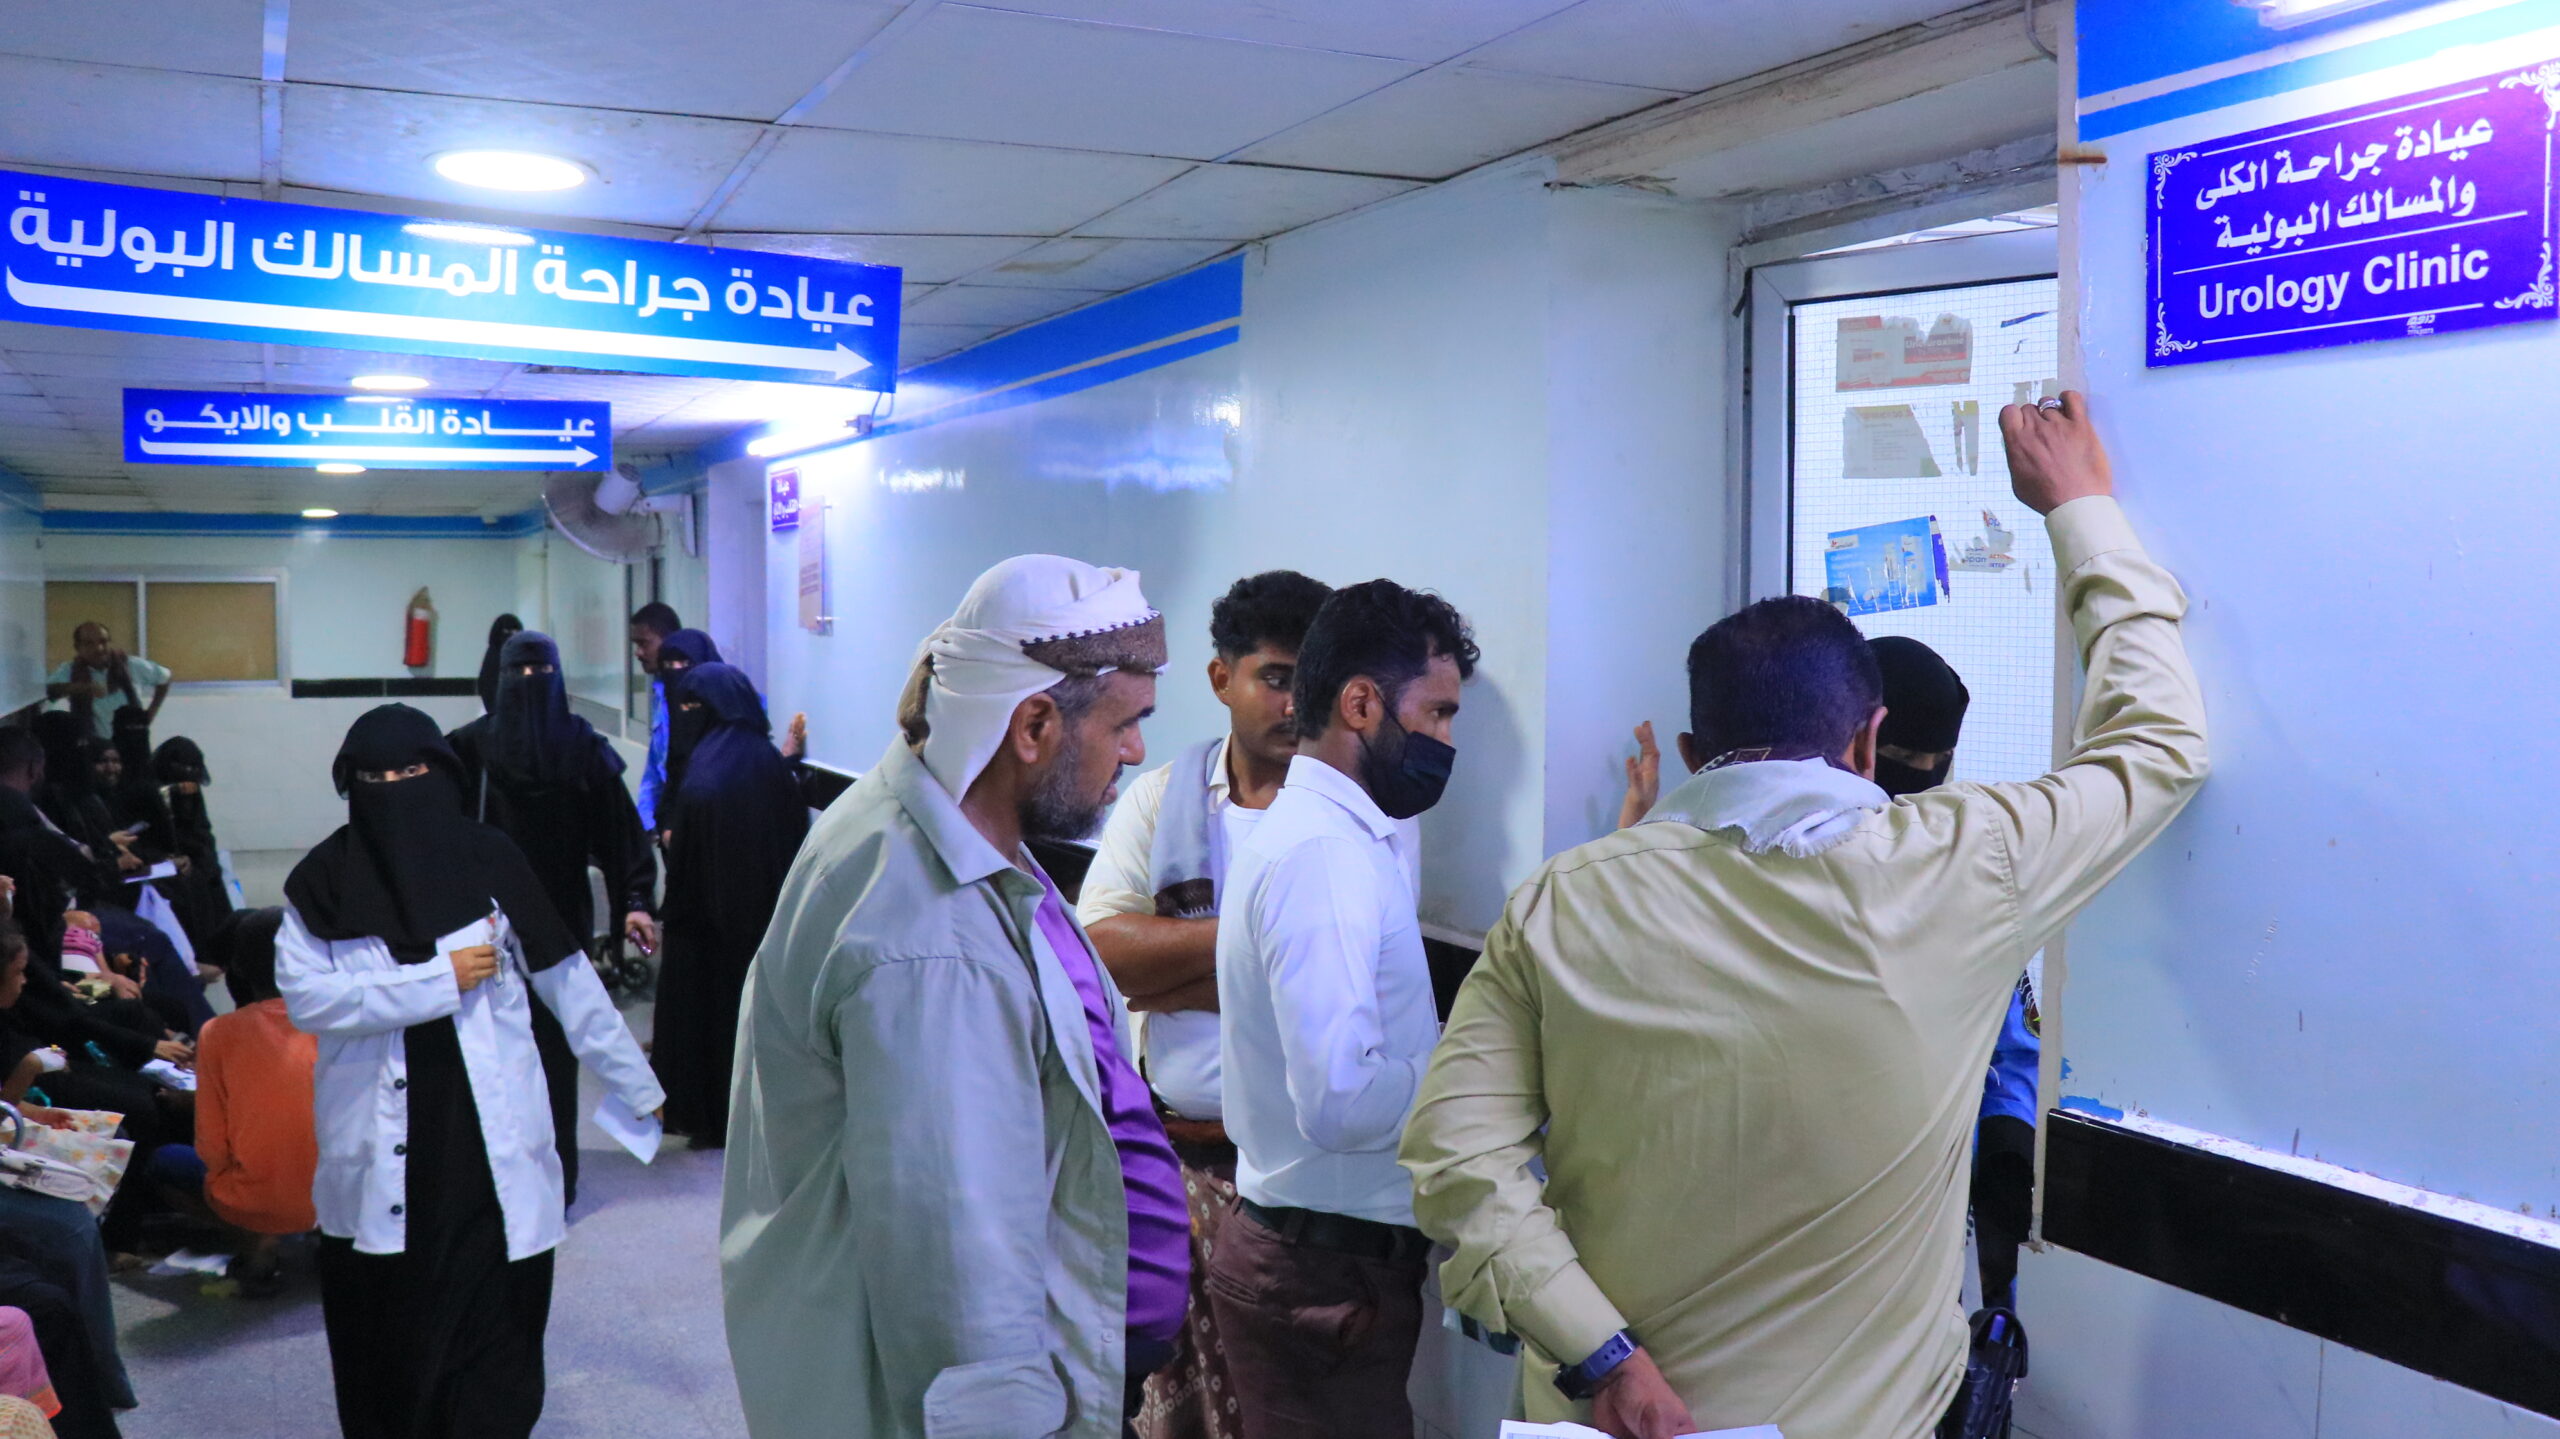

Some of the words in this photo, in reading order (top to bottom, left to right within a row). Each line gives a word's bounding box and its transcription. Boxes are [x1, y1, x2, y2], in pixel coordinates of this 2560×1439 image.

[2275, 141, 2388, 184] جراحة
[2395, 117, 2494, 162] عيادة
[2195, 158, 2269, 211] الكلى
[2336, 175, 2477, 229] والمسالك
[9, 190, 236, 278] البولية
[2213, 203, 2330, 256] البولية
[251, 229, 519, 297] المسالك
[532, 244, 711, 322] جراحة
[2199, 271, 2350, 319] Urology
[2363, 243, 2490, 296] Clinic
[724, 266, 875, 334] عيادة
[144, 403, 292, 436] والايكو
[298, 405, 436, 438] القلب
[441, 406, 596, 442] عيادة
